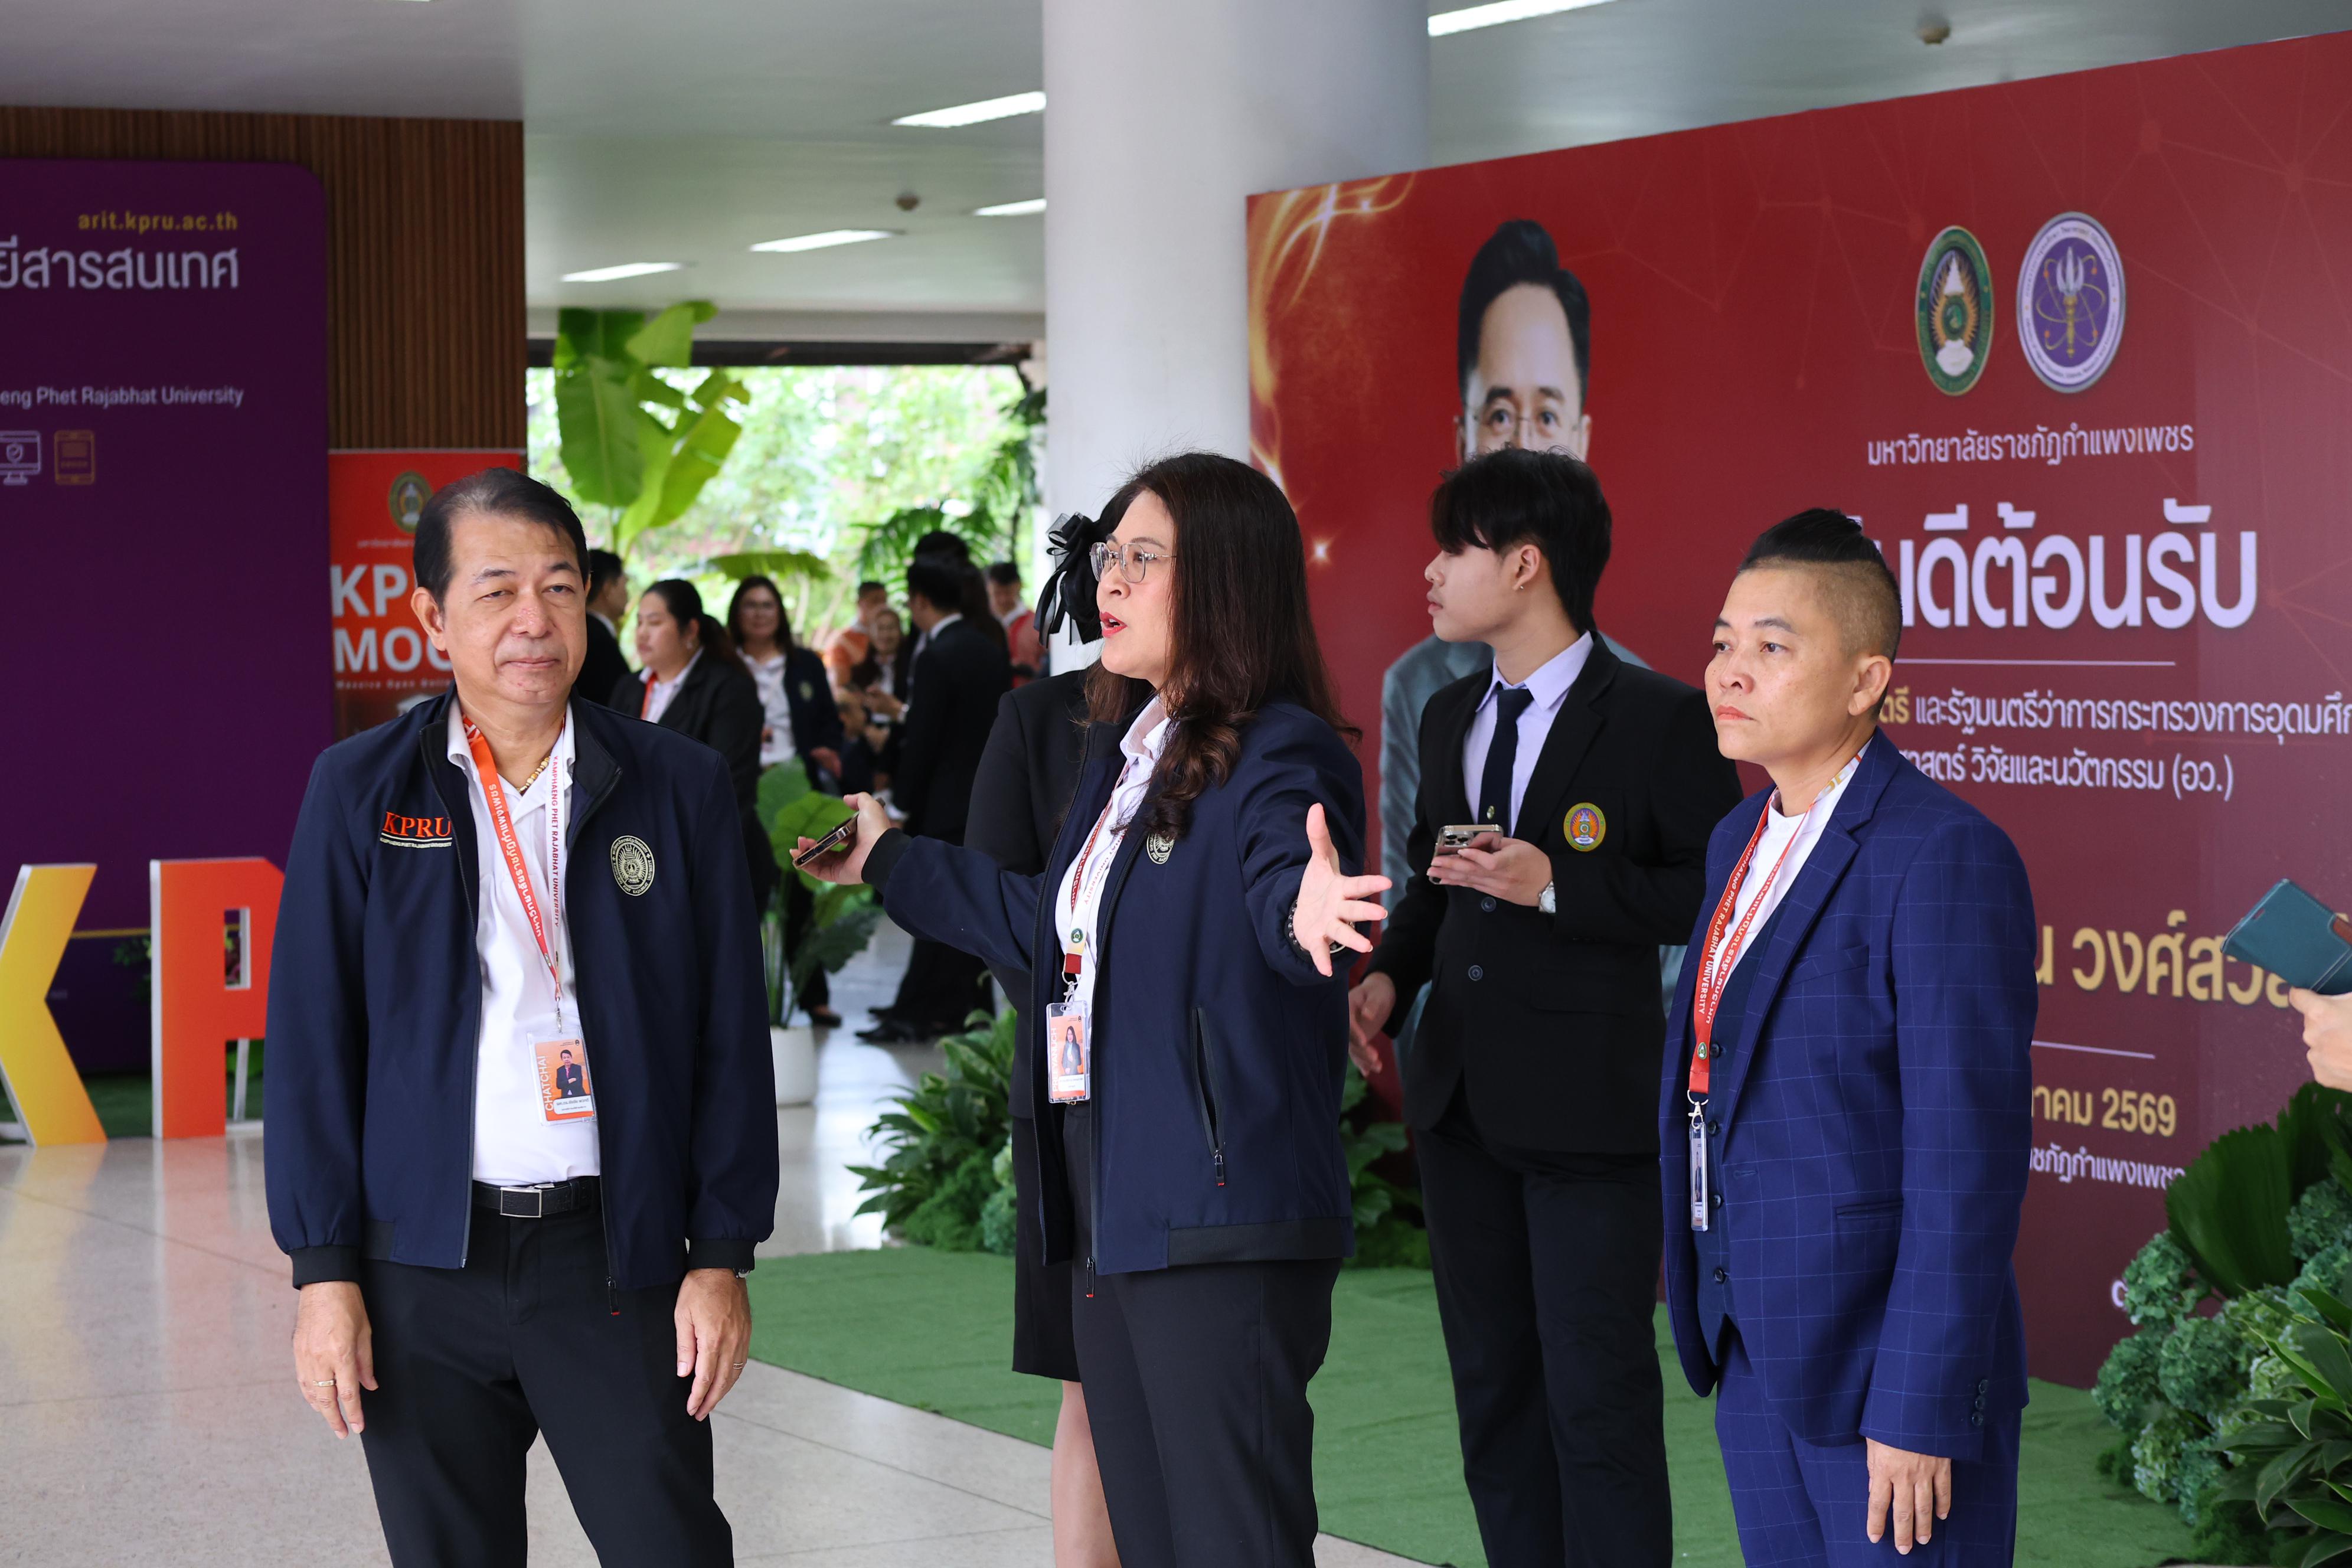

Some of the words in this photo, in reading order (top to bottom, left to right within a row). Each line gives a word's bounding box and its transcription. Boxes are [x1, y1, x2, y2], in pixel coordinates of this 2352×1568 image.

[78, 210, 239, 235] arit.kpru.ac.th
[36, 387, 77, 406] Phet
[81, 386, 157, 409] Rajabhat
[161, 385, 244, 407] University
[1867, 422, 2194, 466] มหาวิทยาลัยราชภัฏกำแพงเพชร
[329, 564, 417, 618] KP
[550, 755, 559, 806] KAMPHAENG
[1971, 744, 2165, 792] วิจัยและนวัตกรรม
[2172, 752, 2235, 802] (อว.)
[382, 811, 452, 838] KPRU
[1730, 835, 1759, 890] KAMPHAENG
[552, 877, 560, 927] UNIVERSITY
[1723, 889, 1736, 914] PHET
[1709, 912, 1726, 958] RAJABHAT
[1698, 960, 1713, 1015] UNIVERSITY
[537, 1055, 554, 1112] CHATCHAI
[2031, 1085, 2093, 1126] าคม
[2102, 1087, 2177, 1138] 2569
